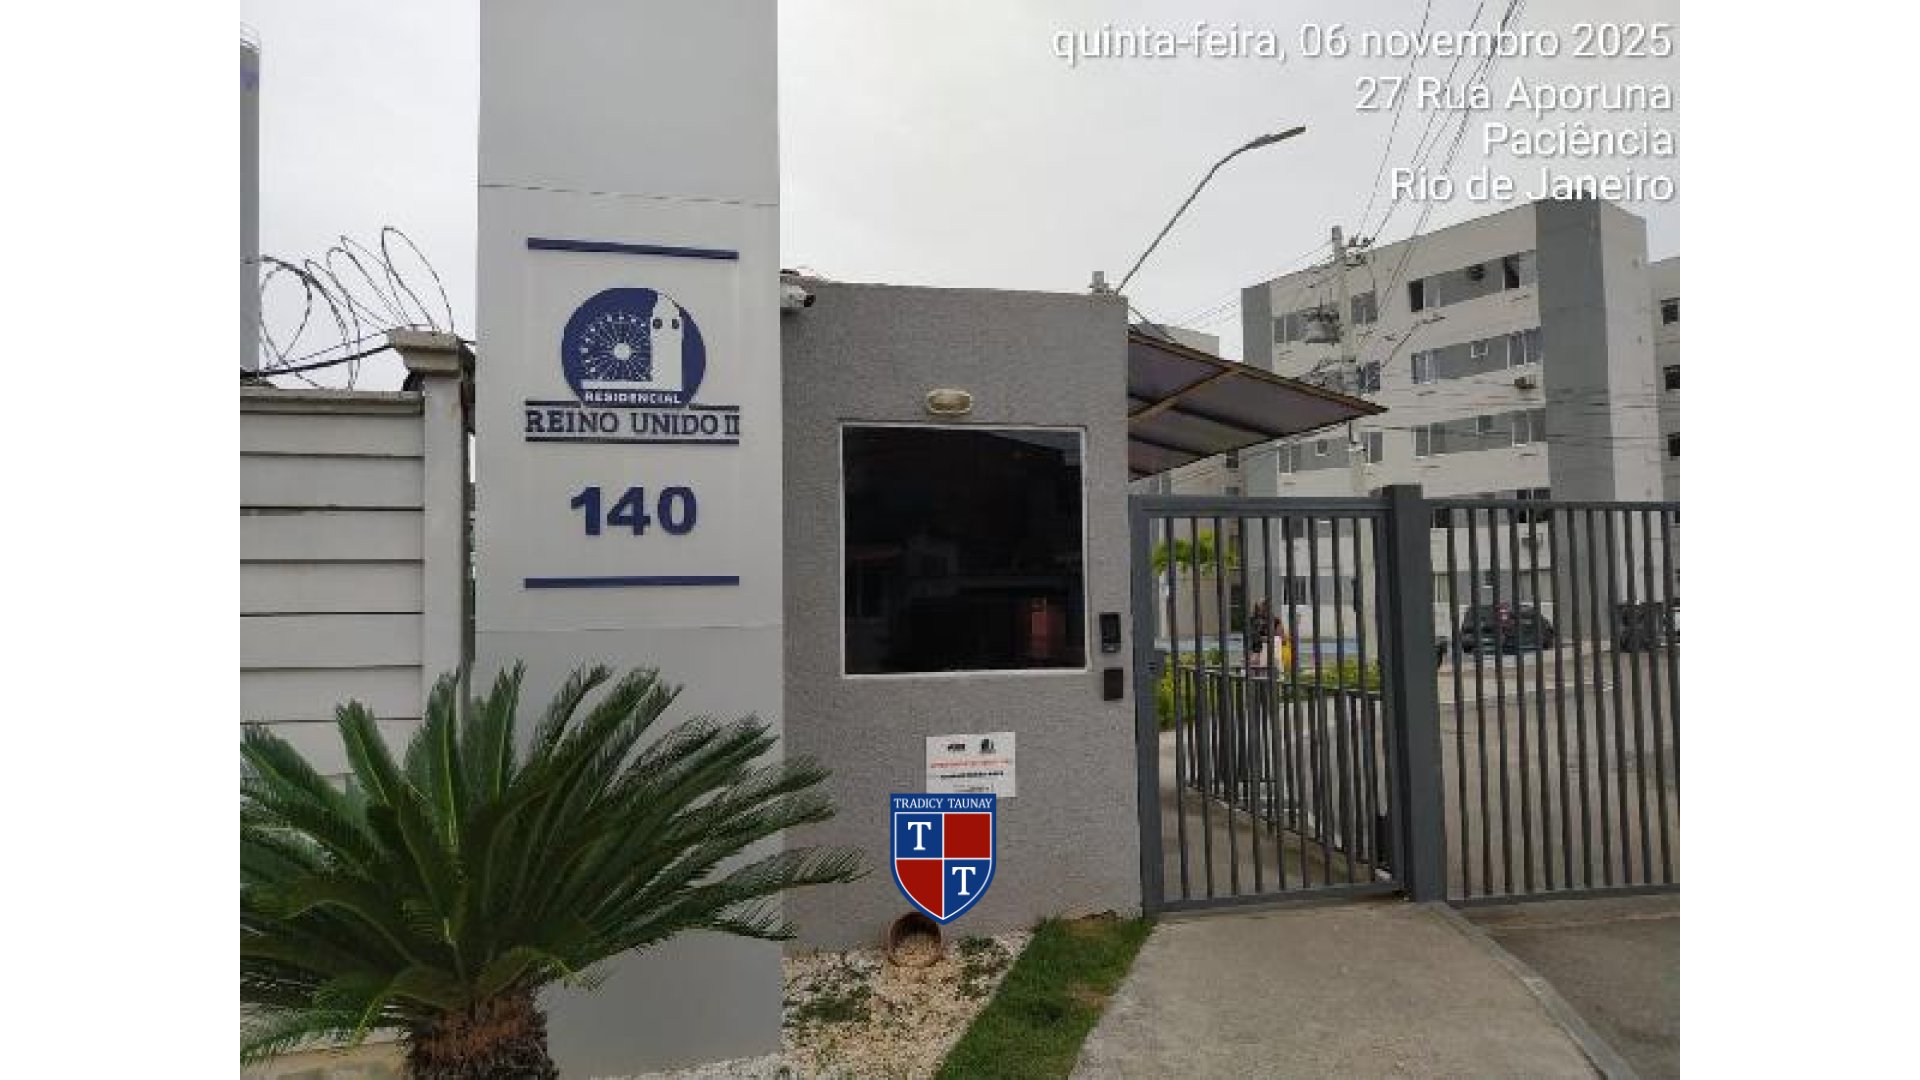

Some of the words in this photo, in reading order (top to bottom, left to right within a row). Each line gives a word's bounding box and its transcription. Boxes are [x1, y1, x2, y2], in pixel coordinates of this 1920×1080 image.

[584, 391, 681, 404] RESIDENCIAL
[525, 409, 620, 434] REINO
[631, 411, 718, 435] UNIDO
[724, 413, 740, 435] II
[571, 486, 698, 536] 140
